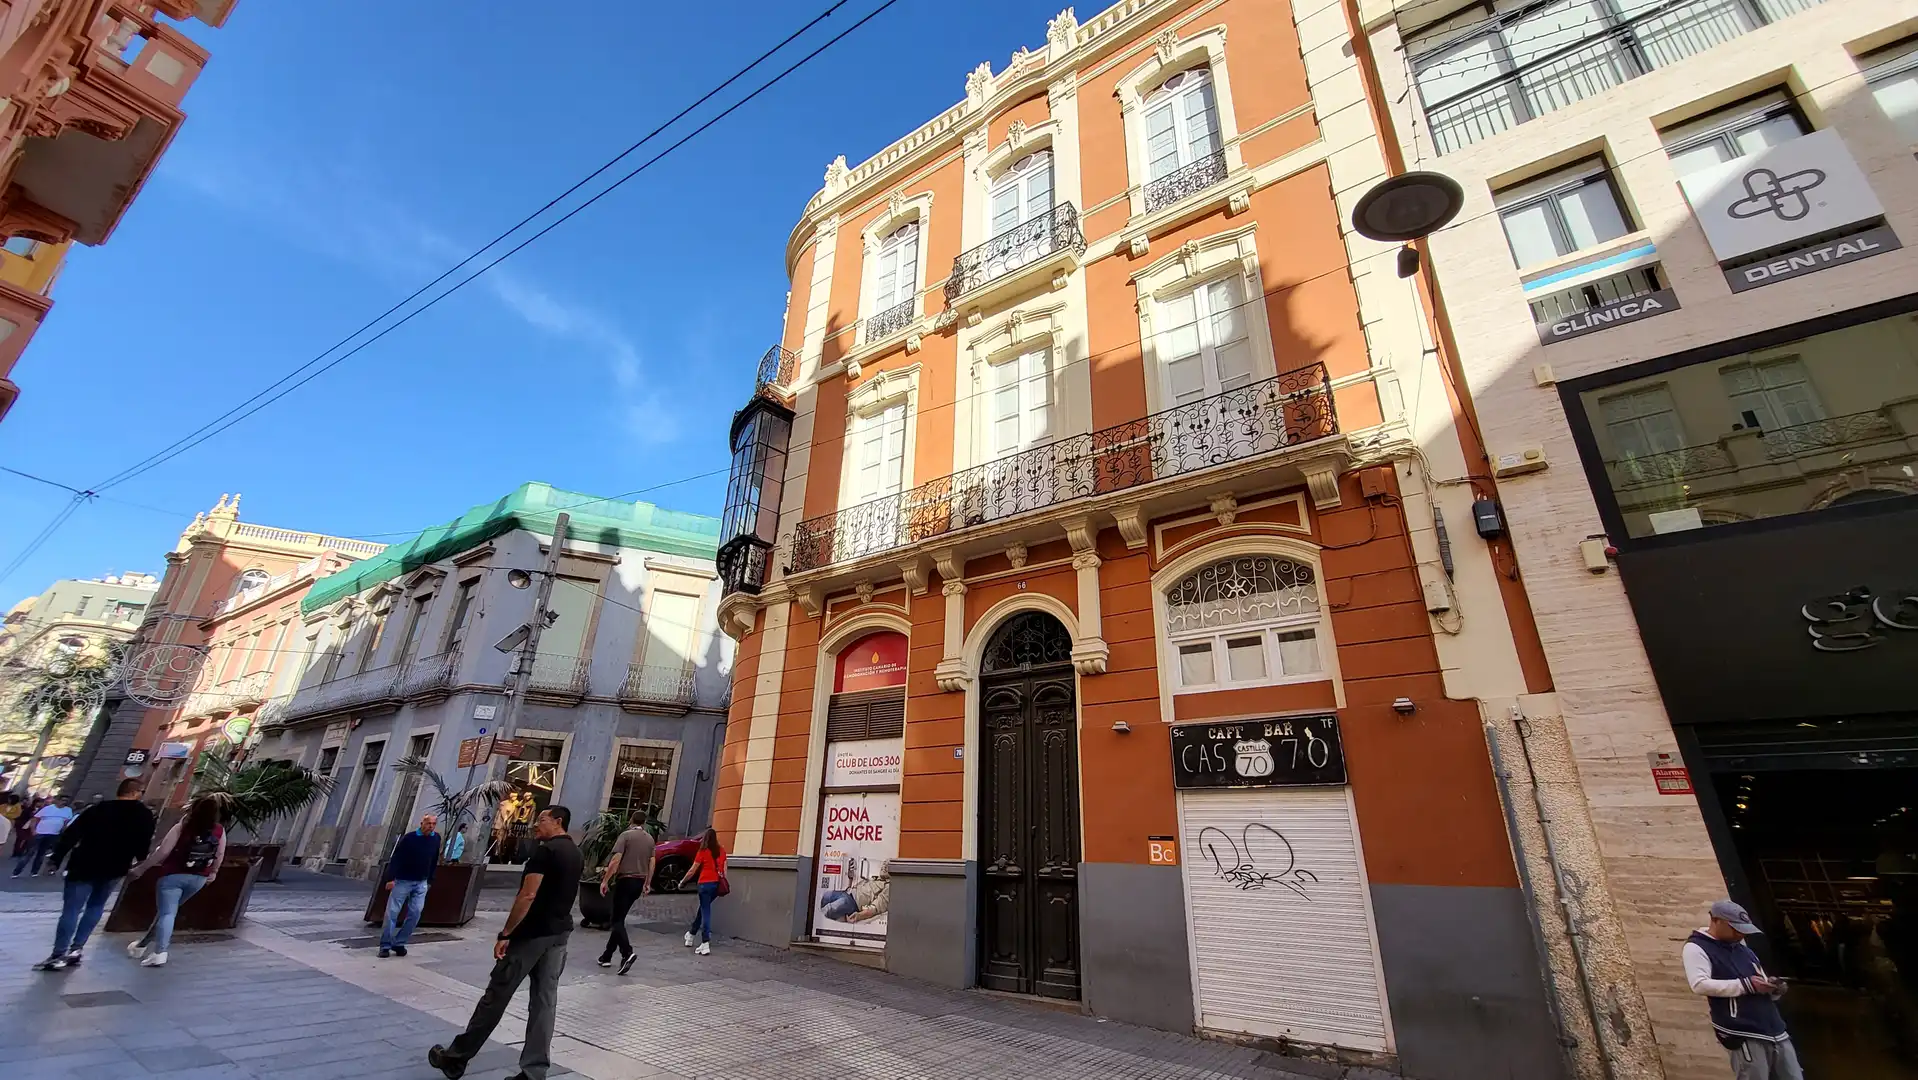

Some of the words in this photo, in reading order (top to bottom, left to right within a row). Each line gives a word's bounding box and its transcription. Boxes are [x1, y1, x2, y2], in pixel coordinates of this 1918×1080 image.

[1743, 238, 1880, 283] DENTAL
[1551, 297, 1663, 336] CLÍNICA
[1017, 581, 1026, 590] 66
[1263, 721, 1294, 737] BAR
[1320, 718, 1333, 729] TF
[1181, 743, 1227, 773] CAS
[1280, 737, 1329, 770] 70
[1237, 744, 1267, 753] CASTILLO
[621, 763, 668, 775] Stradivarius
[836, 758, 857, 769] CLUB
[857, 757, 867, 767] DE
[868, 756, 883, 767] LOS
[884, 755, 900, 766] 300
[1240, 755, 1268, 775] 70
[828, 806, 870, 823] DONA
[826, 824, 883, 841] SANGRE
